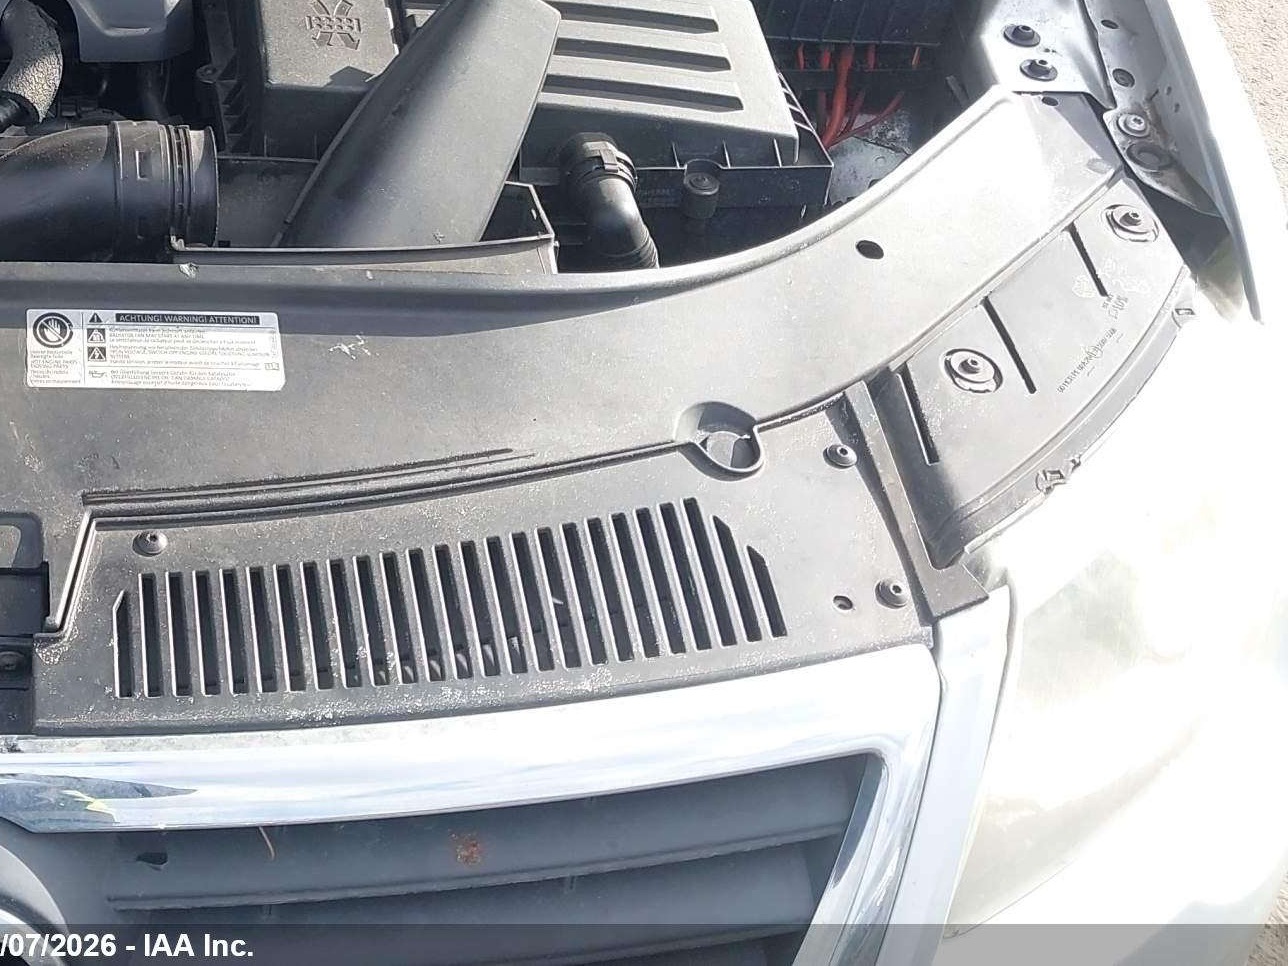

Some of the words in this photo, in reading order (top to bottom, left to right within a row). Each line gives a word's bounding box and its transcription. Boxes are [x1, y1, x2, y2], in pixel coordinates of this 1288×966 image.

[119, 313, 161, 323] ACHTUNG!
[163, 314, 207, 324] WARNING!
[208, 315, 257, 325] ATTENTION!
